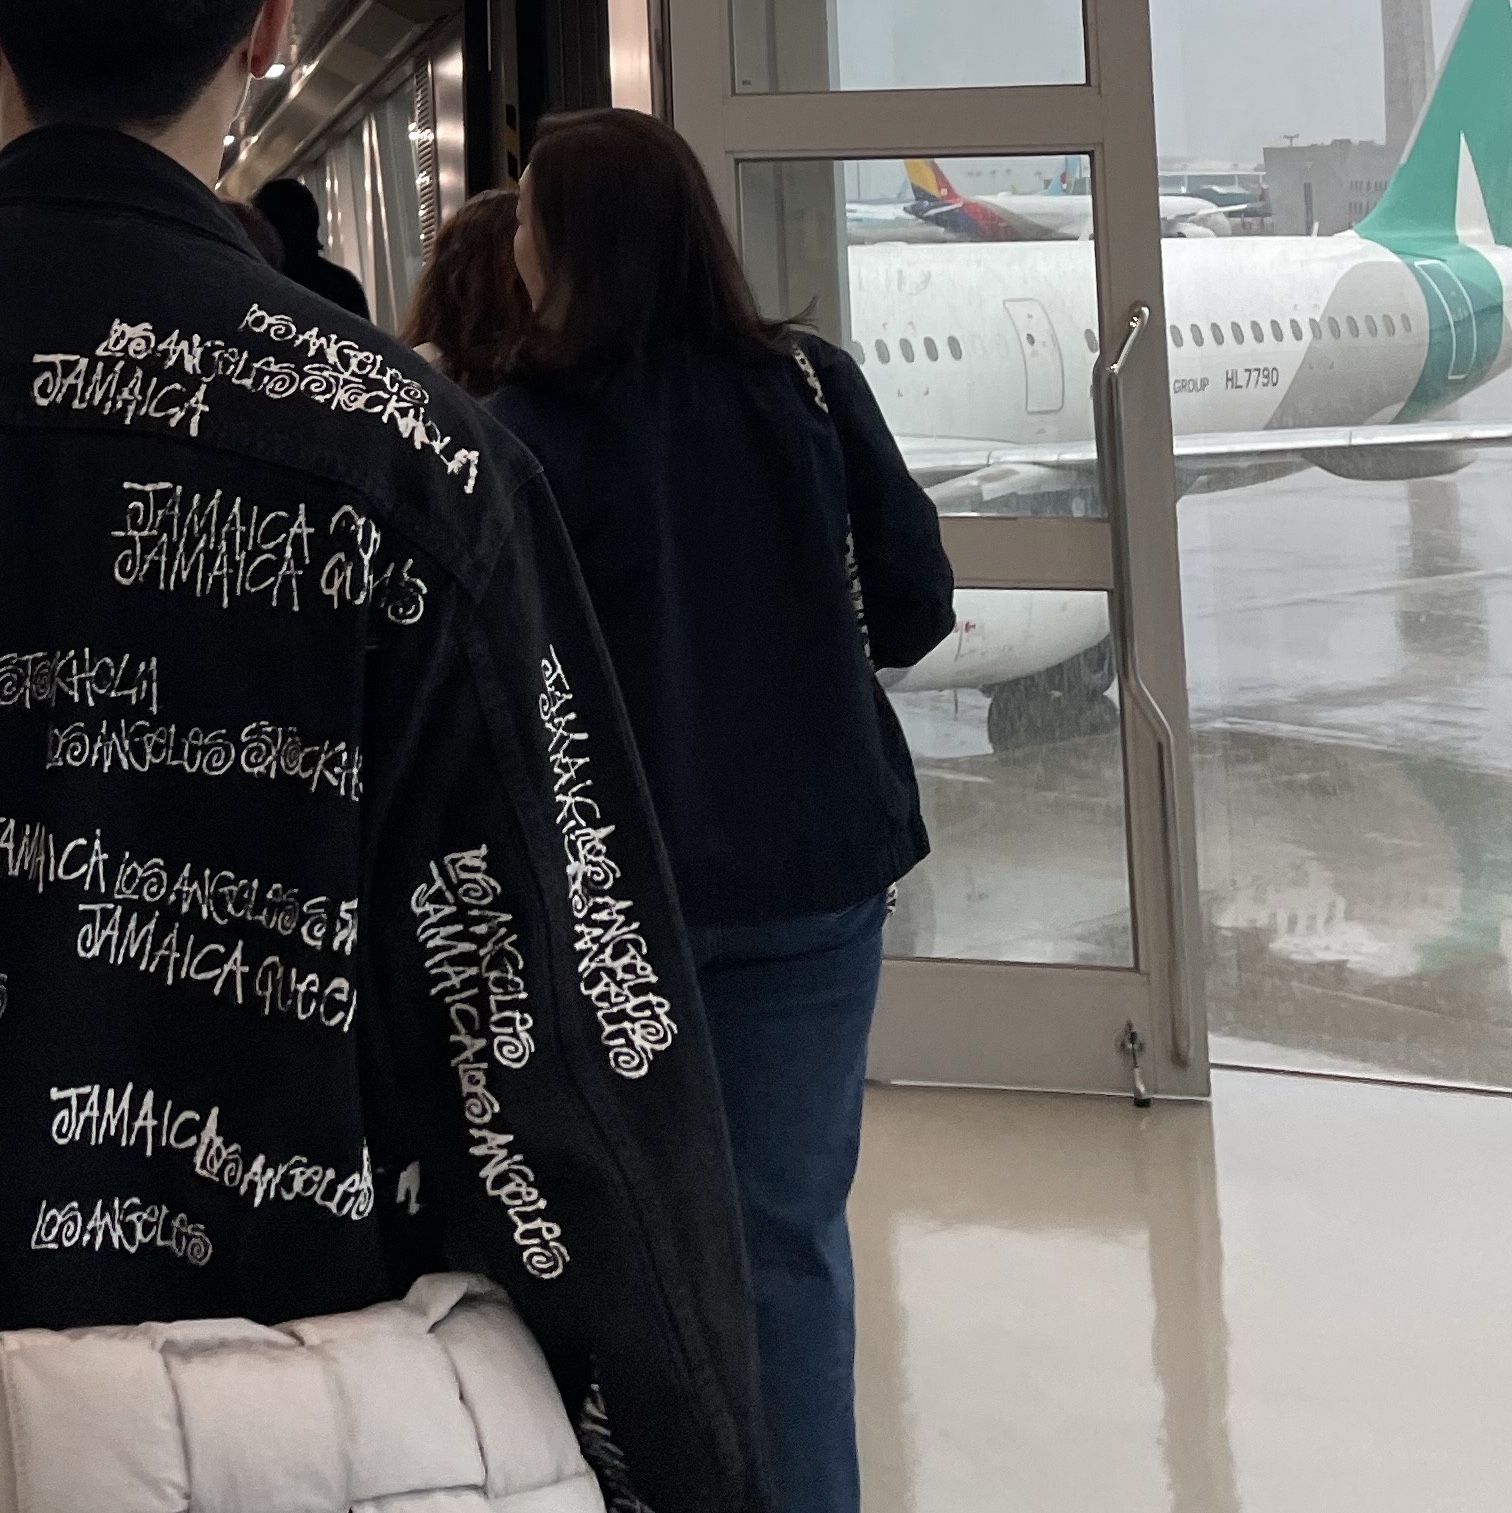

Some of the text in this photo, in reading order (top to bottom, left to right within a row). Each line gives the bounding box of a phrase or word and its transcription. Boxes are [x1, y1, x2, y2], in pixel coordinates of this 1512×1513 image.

[32, 354, 210, 437] JAMAICA
[1173, 366, 1280, 394] GROUP HL7790
[77, 903, 249, 1005] JAMAICA
[50, 1081, 224, 1158] JAMAICA
[31, 1199, 83, 1250] LOS
